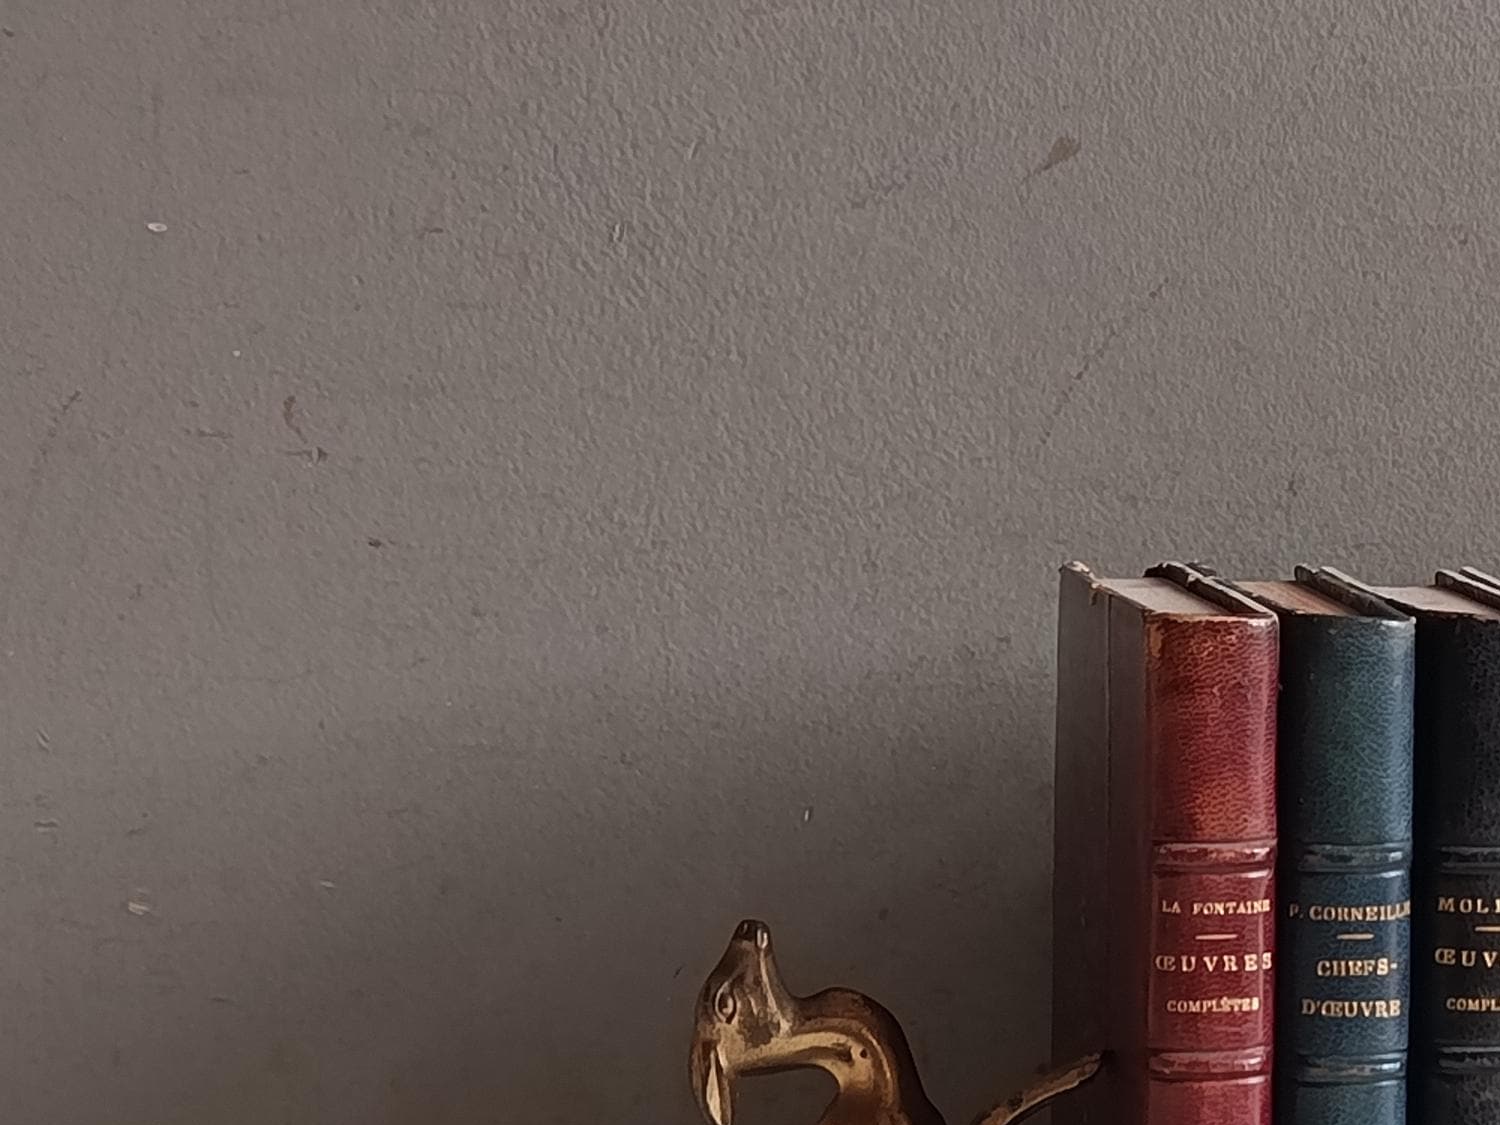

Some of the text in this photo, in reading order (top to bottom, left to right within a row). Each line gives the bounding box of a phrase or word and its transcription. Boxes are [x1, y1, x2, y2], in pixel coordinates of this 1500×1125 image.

[1162, 899, 1270, 915] LA FONTAINE
[1289, 904, 1303, 917] P.
[1155, 952, 1272, 972] ŒUVRES
[1317, 958, 1398, 976] CHEFS-
[1302, 999, 1400, 1018] D'ŒUVRE
